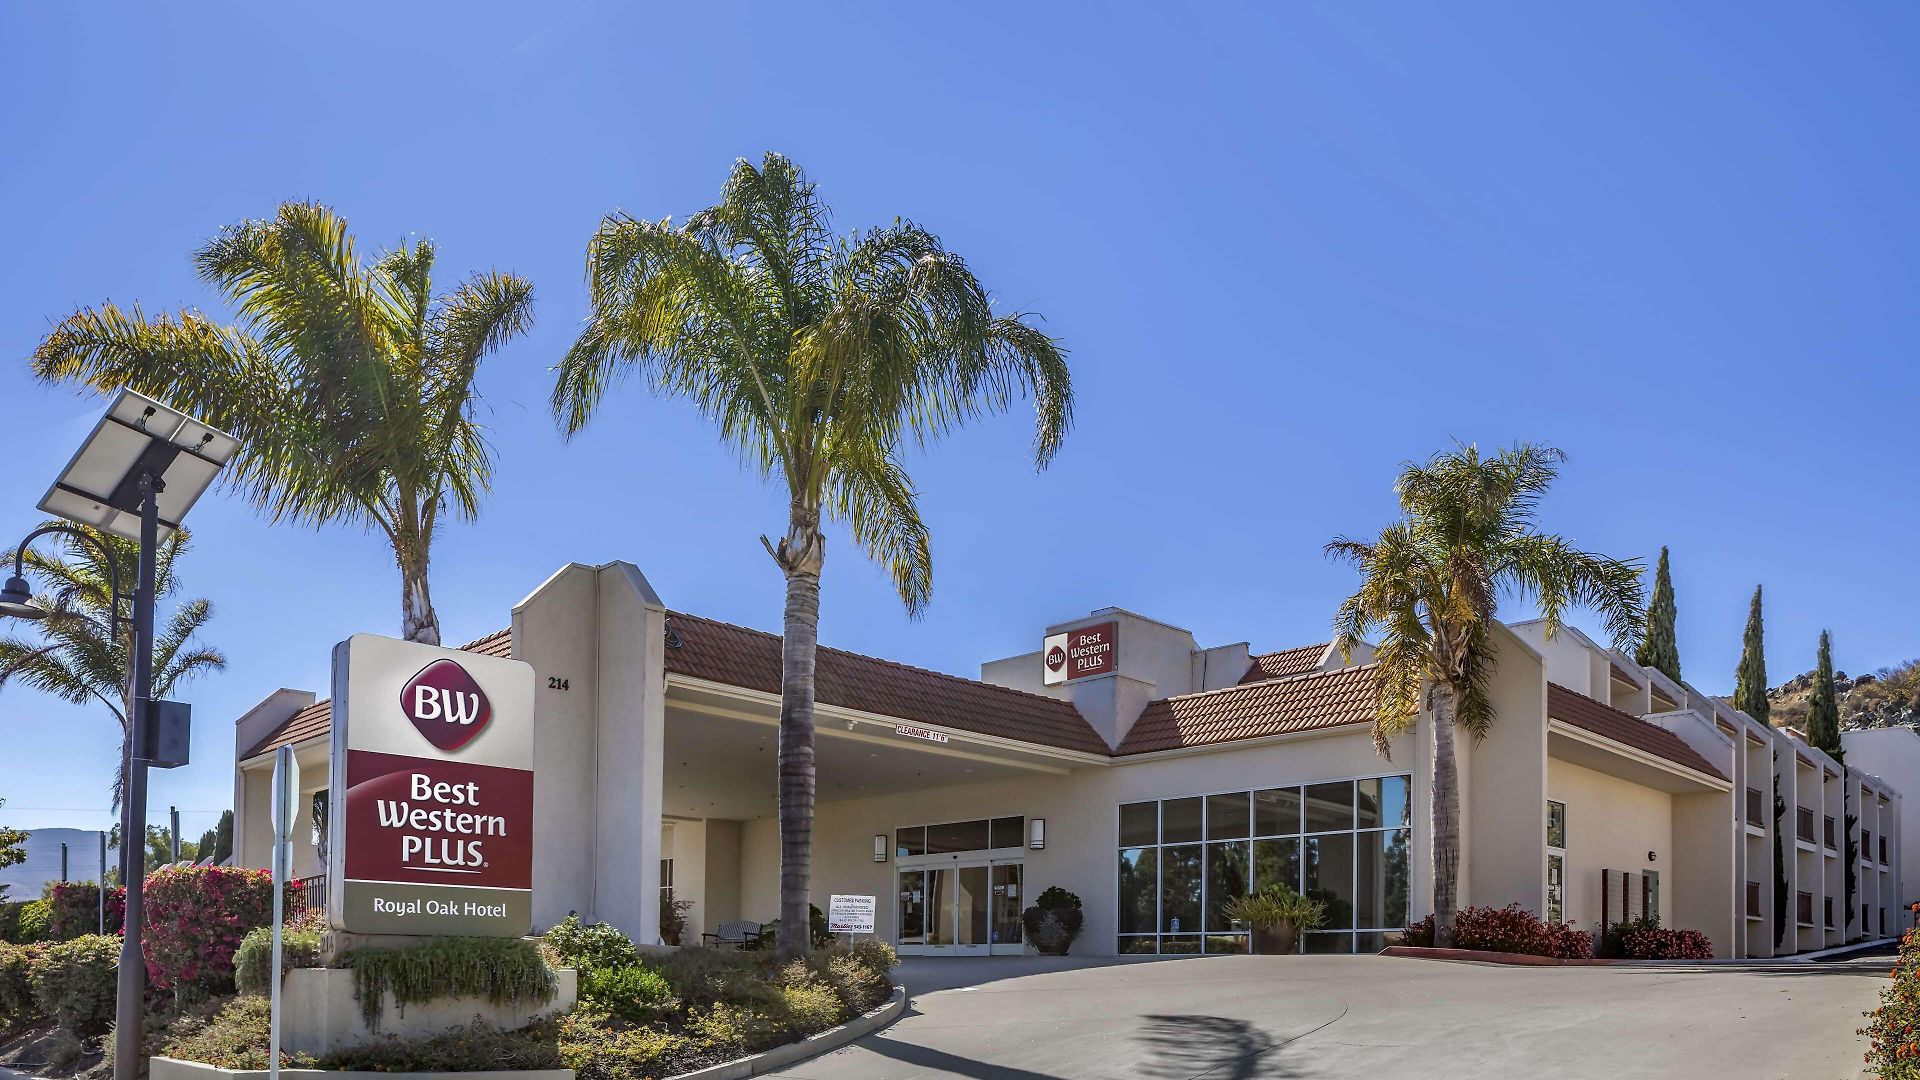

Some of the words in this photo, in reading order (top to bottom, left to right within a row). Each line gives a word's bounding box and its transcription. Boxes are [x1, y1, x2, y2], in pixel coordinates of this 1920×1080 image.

[1080, 632, 1102, 646] Best
[1070, 643, 1110, 658] Western
[1048, 653, 1064, 665] BW
[548, 676, 570, 691] 214
[414, 685, 479, 725] BW
[897, 725, 931, 739] CLEARANCE
[411, 773, 480, 806] Best
[377, 799, 507, 837] Western
[374, 898, 421, 916] Royal
[426, 900, 459, 915] Oak
[464, 902, 506, 917] Hotel
